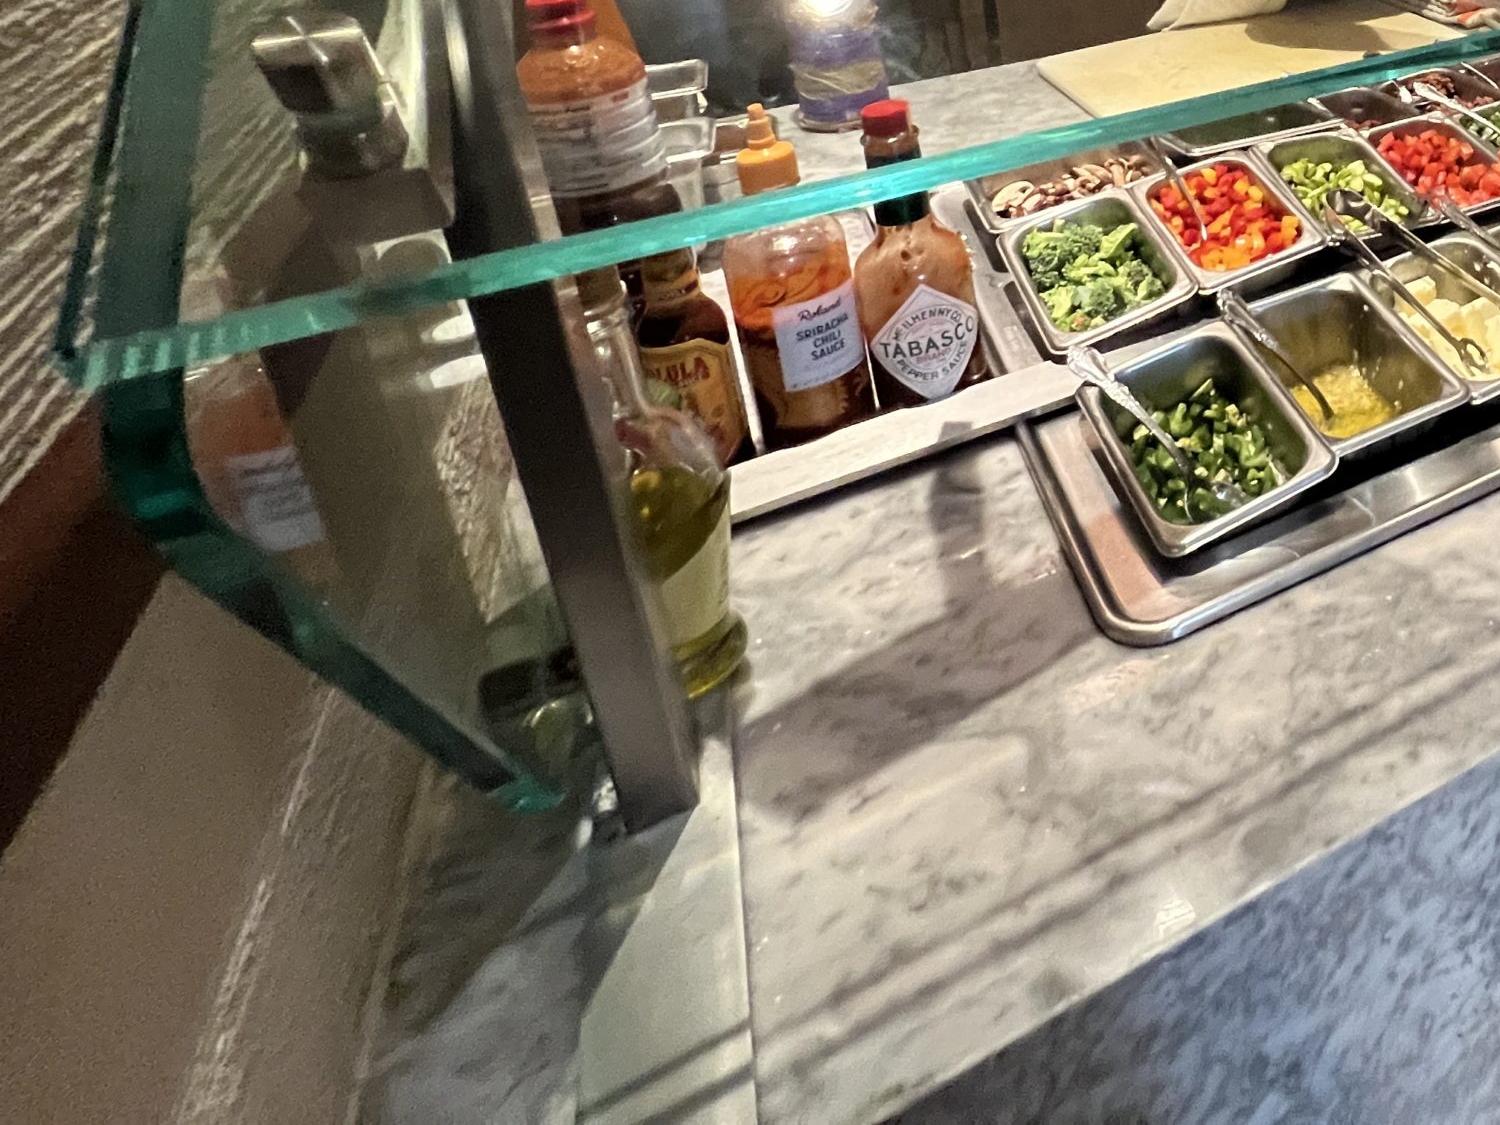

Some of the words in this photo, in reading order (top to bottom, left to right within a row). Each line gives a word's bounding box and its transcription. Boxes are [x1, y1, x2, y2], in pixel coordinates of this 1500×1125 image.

[796, 313, 850, 343] SRIRACHA
[813, 330, 841, 349] CHILI
[878, 315, 975, 360] TABASCO
[811, 338, 846, 362] SAUCE
[896, 358, 940, 381] PEPPER
[941, 341, 968, 375] SAUCE
